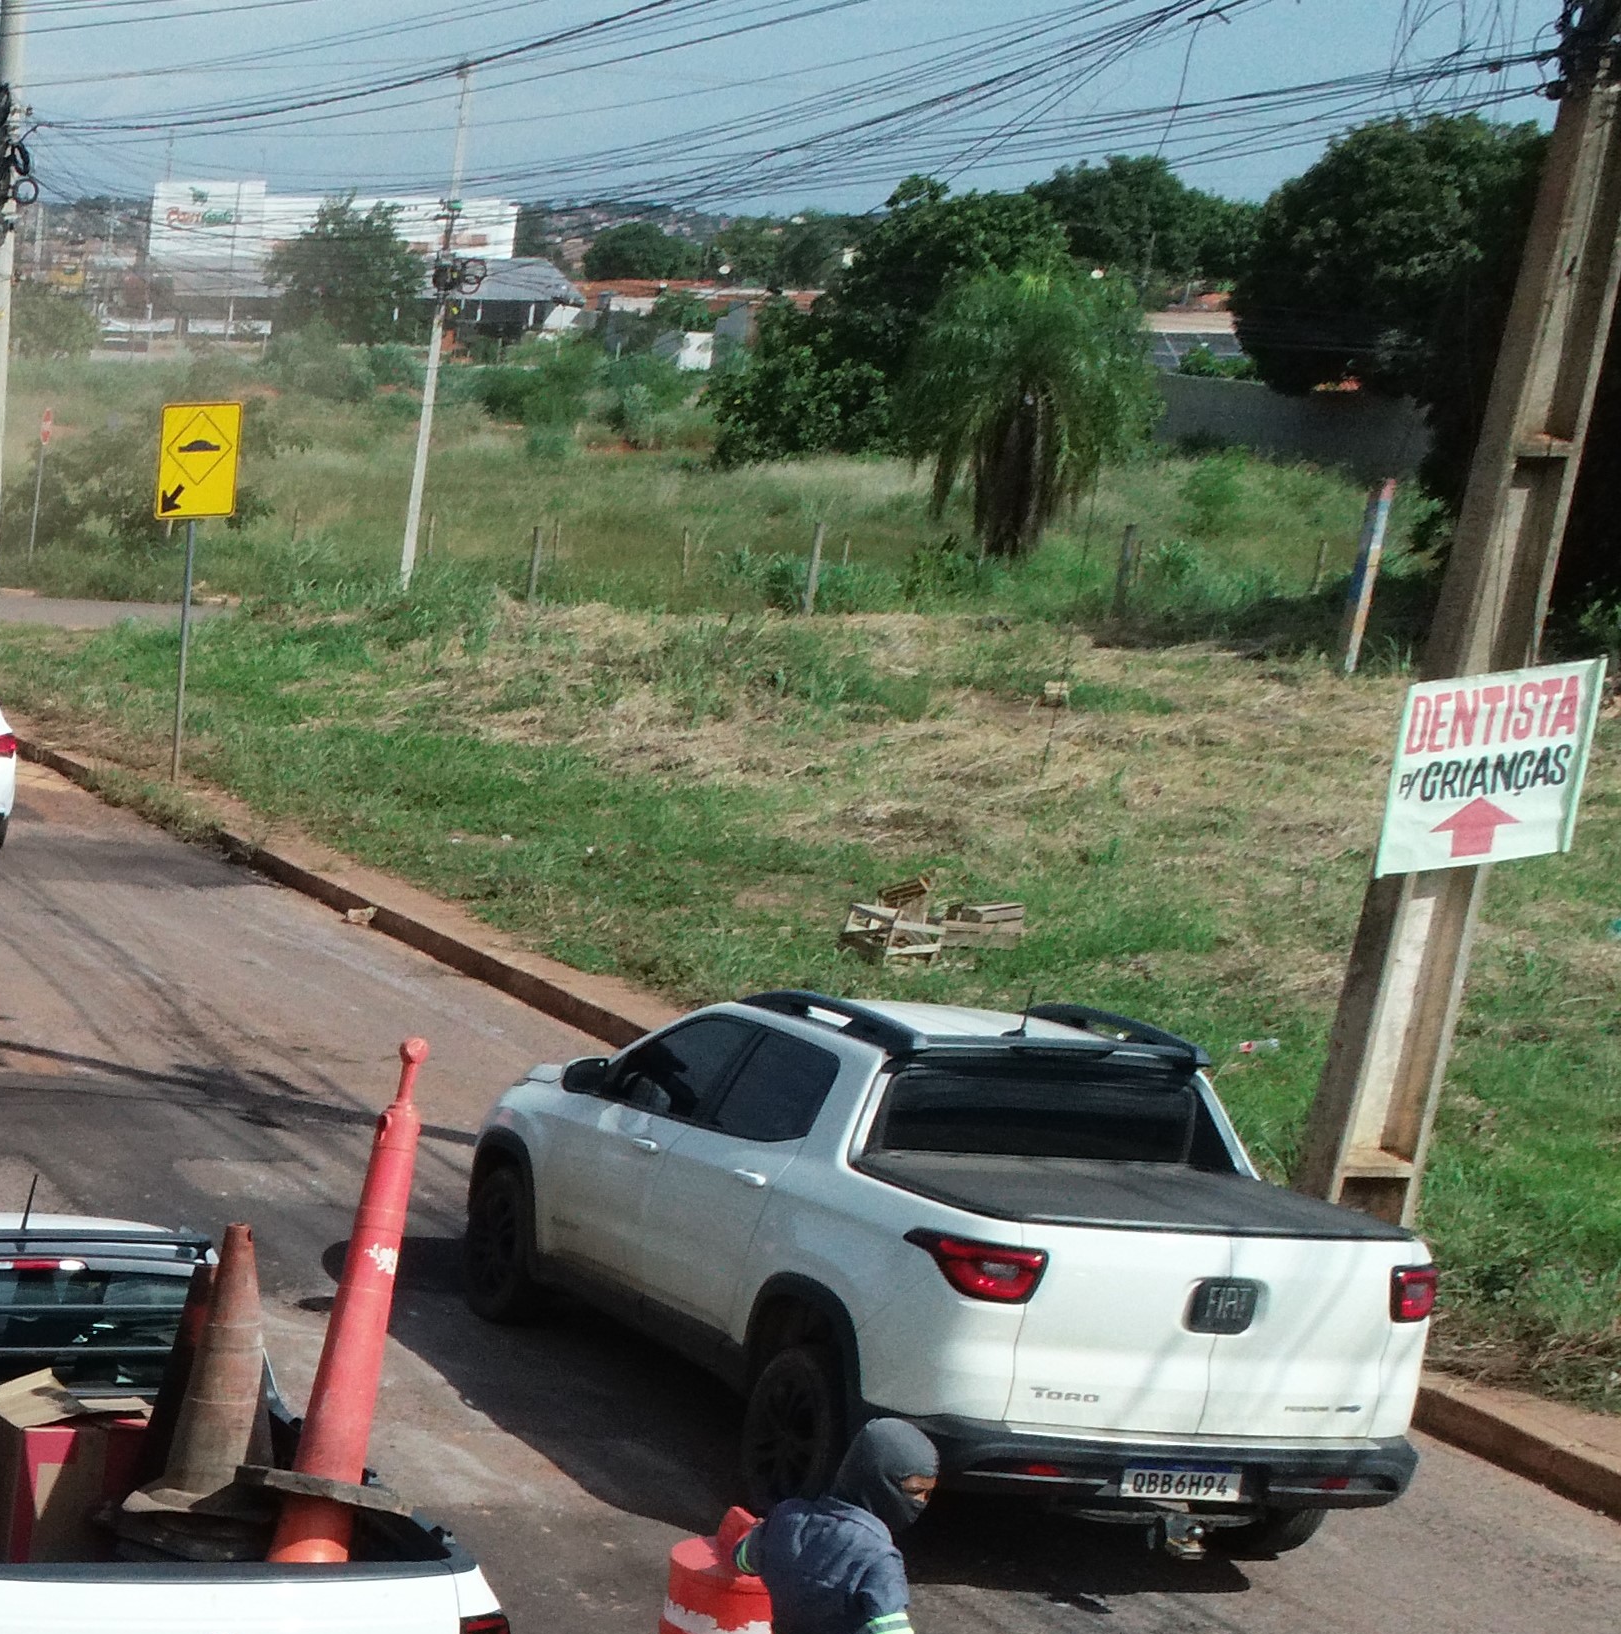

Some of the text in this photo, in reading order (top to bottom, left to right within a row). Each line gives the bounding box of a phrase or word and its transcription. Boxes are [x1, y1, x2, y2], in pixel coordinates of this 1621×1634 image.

[1404, 675, 1579, 755] DENTISTA
[1419, 744, 1573, 802] CRIANÇAS
[1205, 1286, 1253, 1319] FIAT
[1132, 1471, 1228, 1497] QBB6H94
